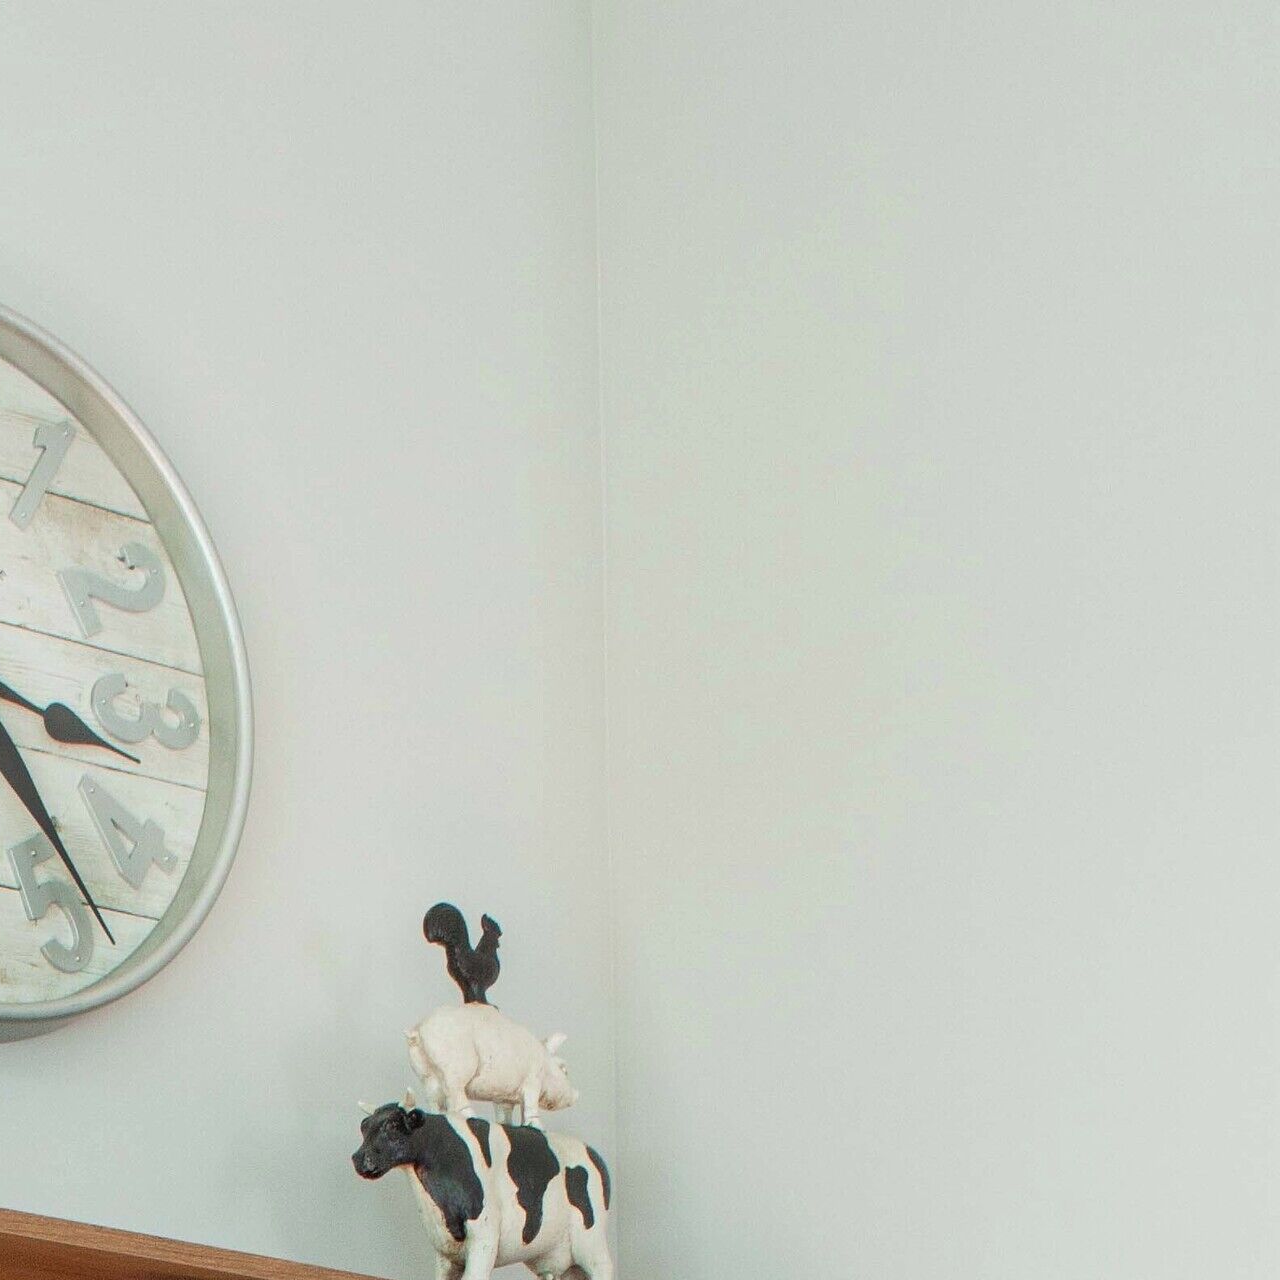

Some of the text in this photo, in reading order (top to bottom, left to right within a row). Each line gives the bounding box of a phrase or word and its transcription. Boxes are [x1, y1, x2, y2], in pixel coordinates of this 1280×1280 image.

[8, 420, 76, 528] 1
[56, 541, 167, 638] 2
[90, 672, 201, 750] 3
[77, 773, 178, 888] 4
[7, 831, 93, 973] 5
